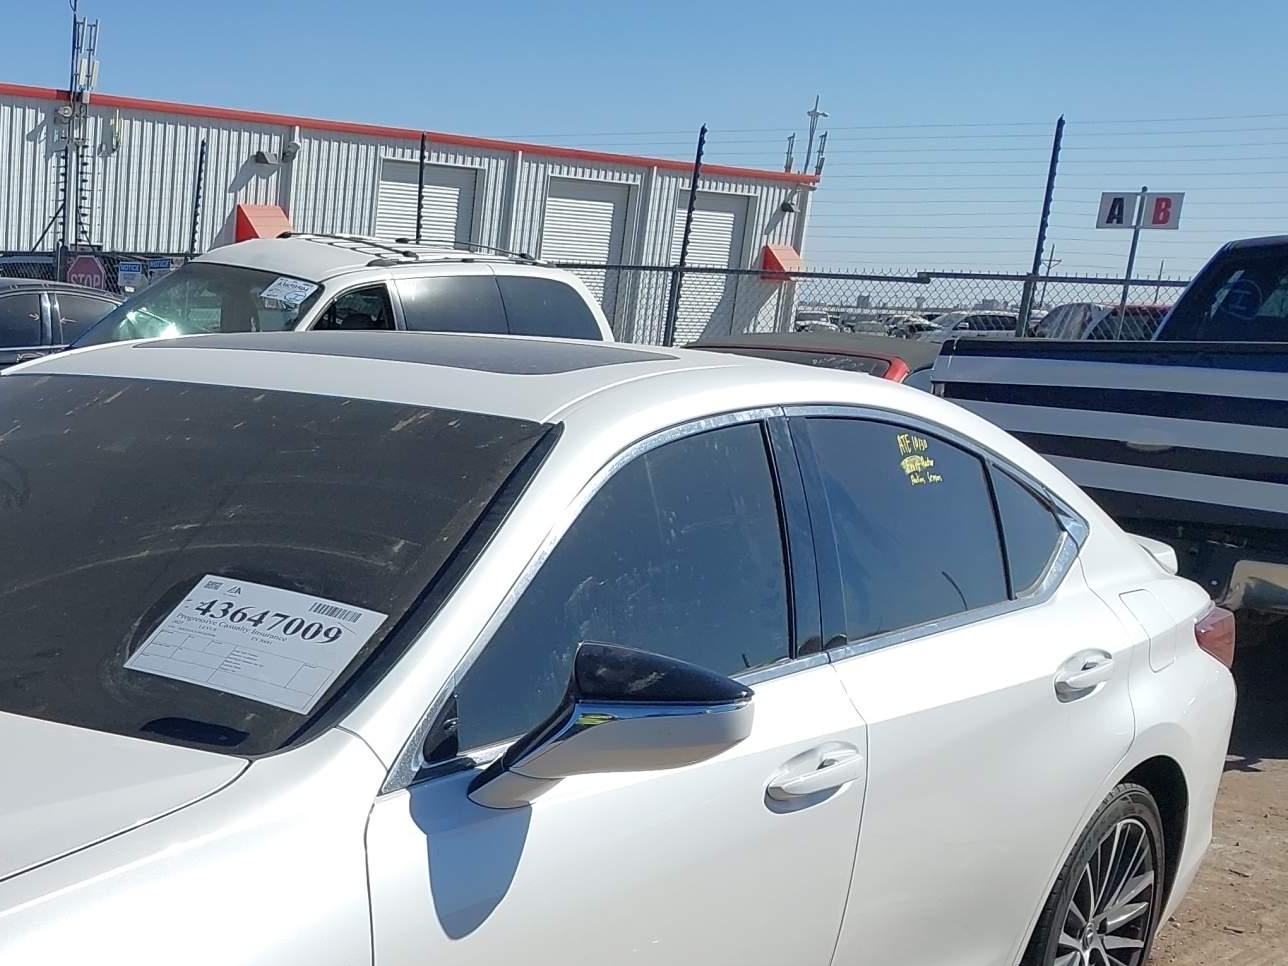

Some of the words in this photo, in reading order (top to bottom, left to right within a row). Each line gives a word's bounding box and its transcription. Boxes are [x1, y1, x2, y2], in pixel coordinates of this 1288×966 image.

[1105, 197, 1124, 224] A
[1151, 197, 1172, 225] B
[71, 273, 101, 289] STOP
[176, 613, 218, 626] Progressive
[218, 620, 250, 634] Casualty
[251, 629, 288, 642] Insurance
[195, 599, 343, 644] 43647009
